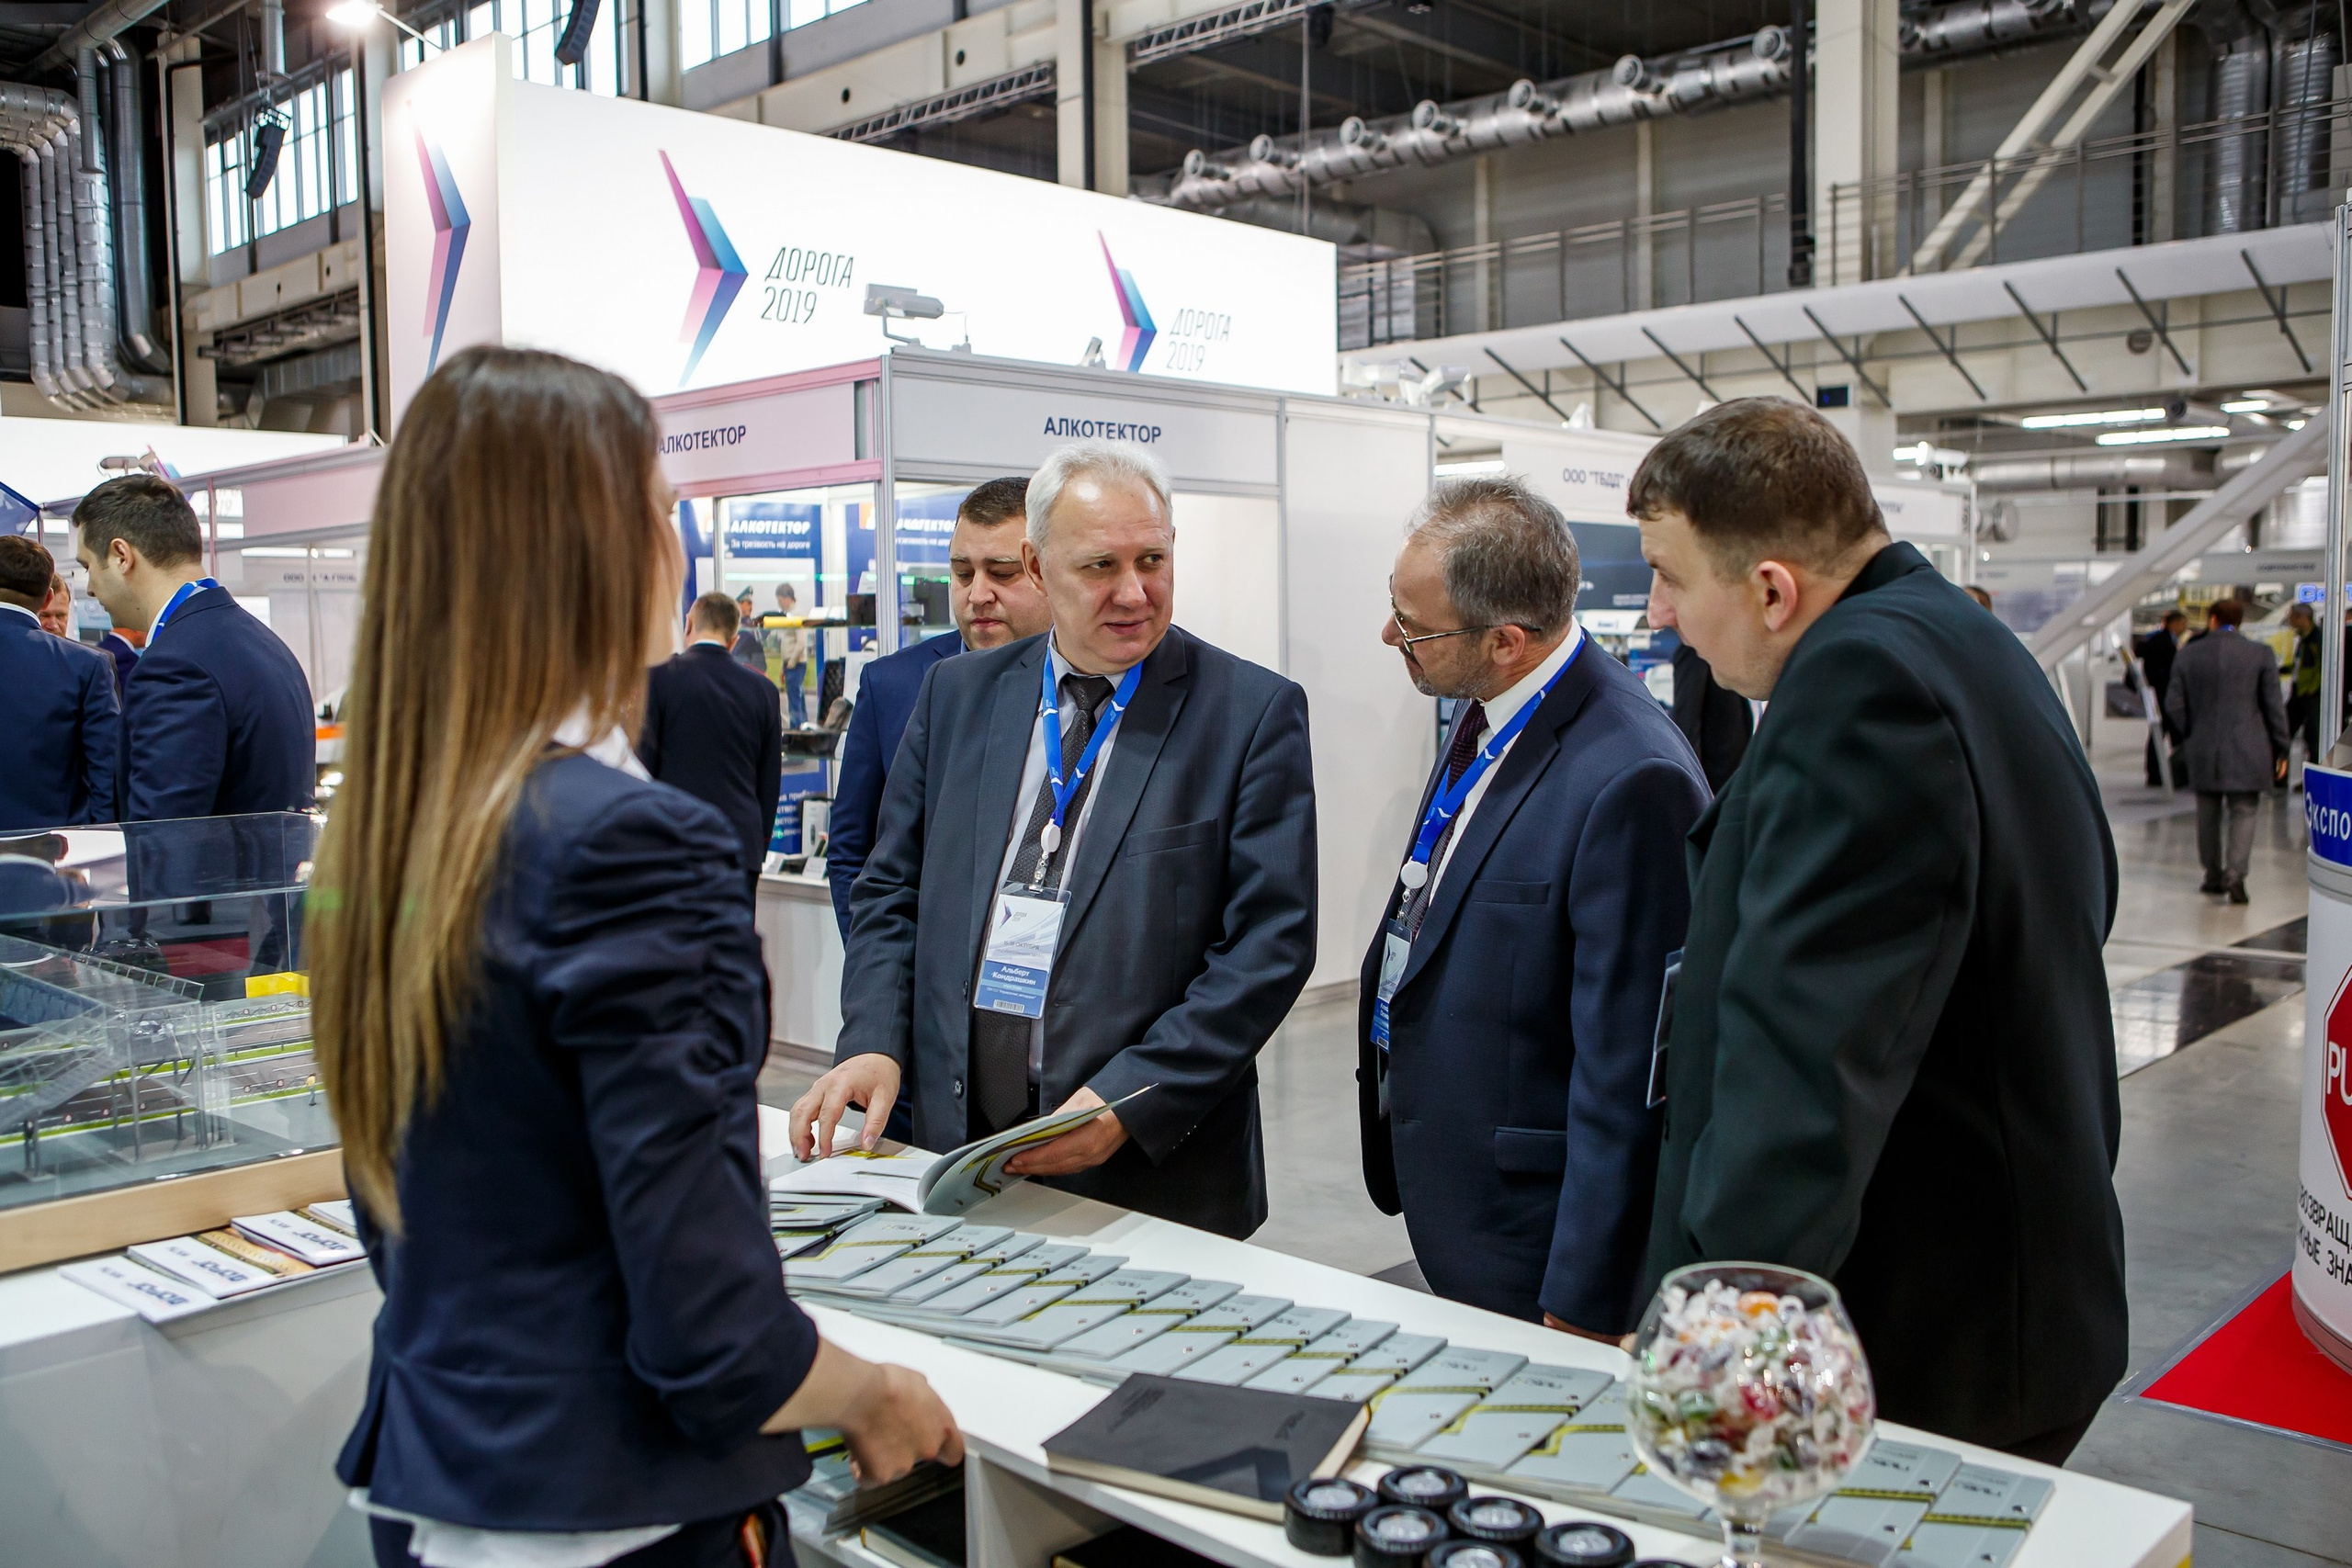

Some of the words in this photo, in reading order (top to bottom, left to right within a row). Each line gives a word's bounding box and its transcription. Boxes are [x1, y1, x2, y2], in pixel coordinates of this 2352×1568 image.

[763, 246, 854, 288] ДОРОГА
[760, 286, 818, 325] 2019
[1169, 308, 1231, 343] ДОРОГА
[1166, 341, 1205, 372] 2019
[1044, 416, 1162, 444] АЛКОТЕКТОР
[1563, 468, 1587, 484] ООО
[730, 519, 811, 536] АЛКОТЕКТОР
[2305, 791, 2352, 840] Экспо
[1001, 965, 1031, 977] Альберт
